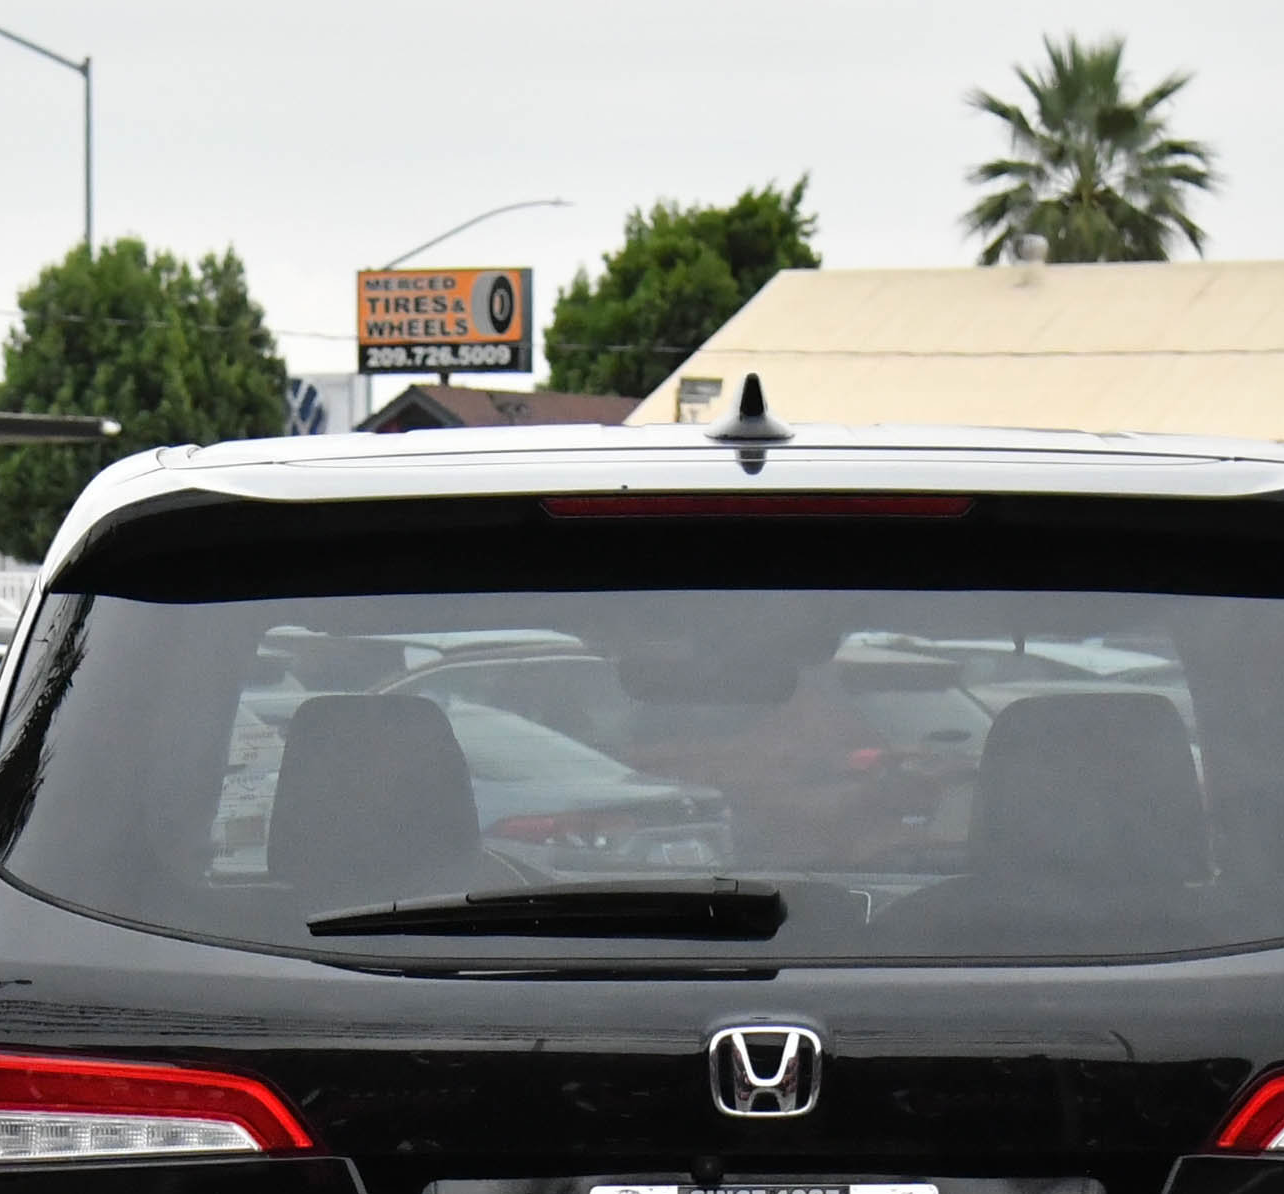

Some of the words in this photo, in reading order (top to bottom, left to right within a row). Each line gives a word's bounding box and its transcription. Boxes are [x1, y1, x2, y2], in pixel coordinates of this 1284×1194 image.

[365, 276, 456, 291] MERCED
[367, 296, 448, 315] TIRES
[452, 300, 466, 313] &
[366, 317, 470, 337] WHEELS
